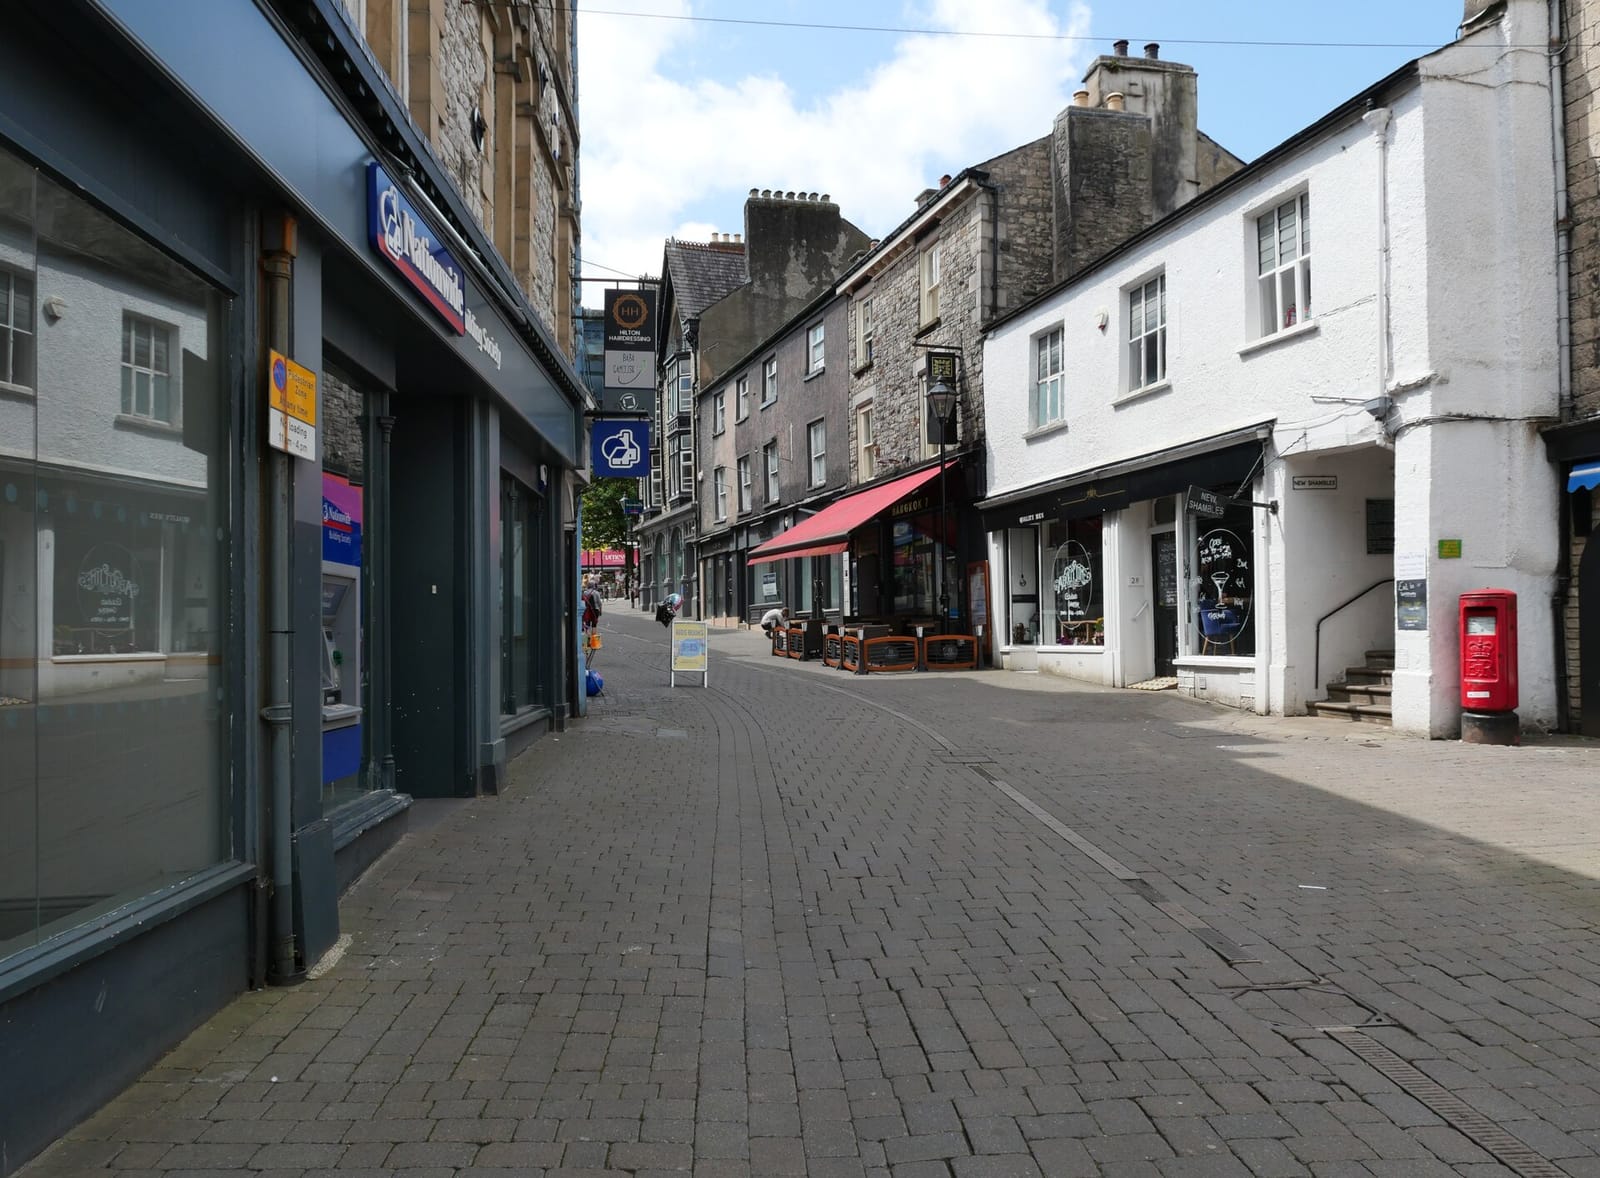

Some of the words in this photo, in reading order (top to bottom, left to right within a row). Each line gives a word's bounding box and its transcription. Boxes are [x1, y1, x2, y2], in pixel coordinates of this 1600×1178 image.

[402, 210, 464, 316] Nationwide
[482, 328, 502, 371] Society
[1189, 500, 1225, 515] SHAMBLES
[1200, 491, 1218, 504] NEW
